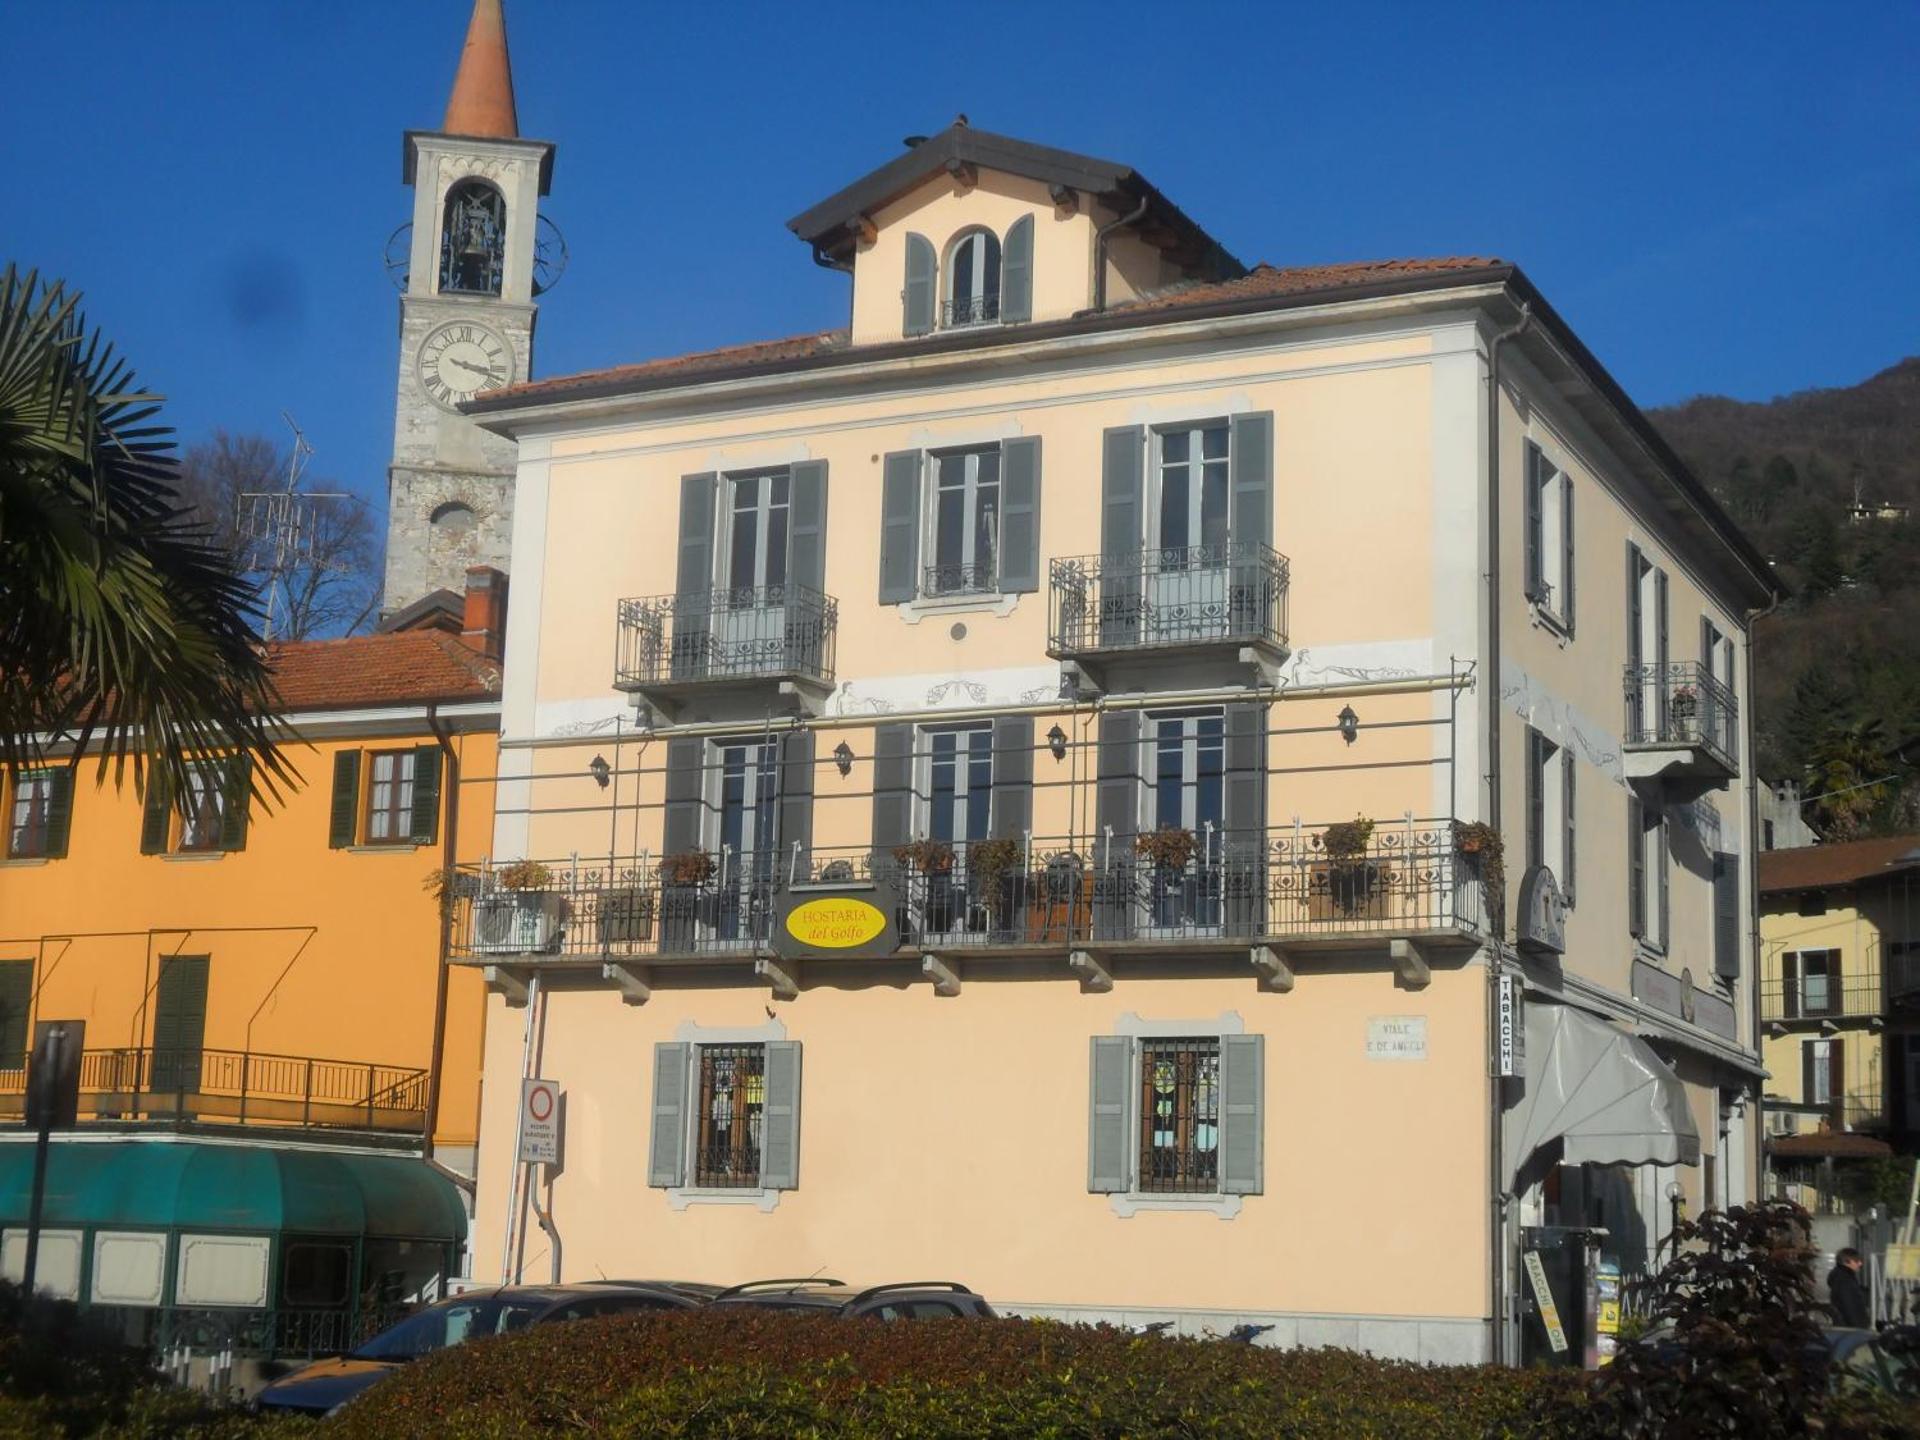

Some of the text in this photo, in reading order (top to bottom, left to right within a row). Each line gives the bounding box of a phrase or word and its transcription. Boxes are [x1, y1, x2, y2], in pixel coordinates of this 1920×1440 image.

[803, 909, 867, 923] HOSTARIA
[808, 925, 864, 942] del Golfo
[1502, 981, 1511, 1070] TABACCHI
